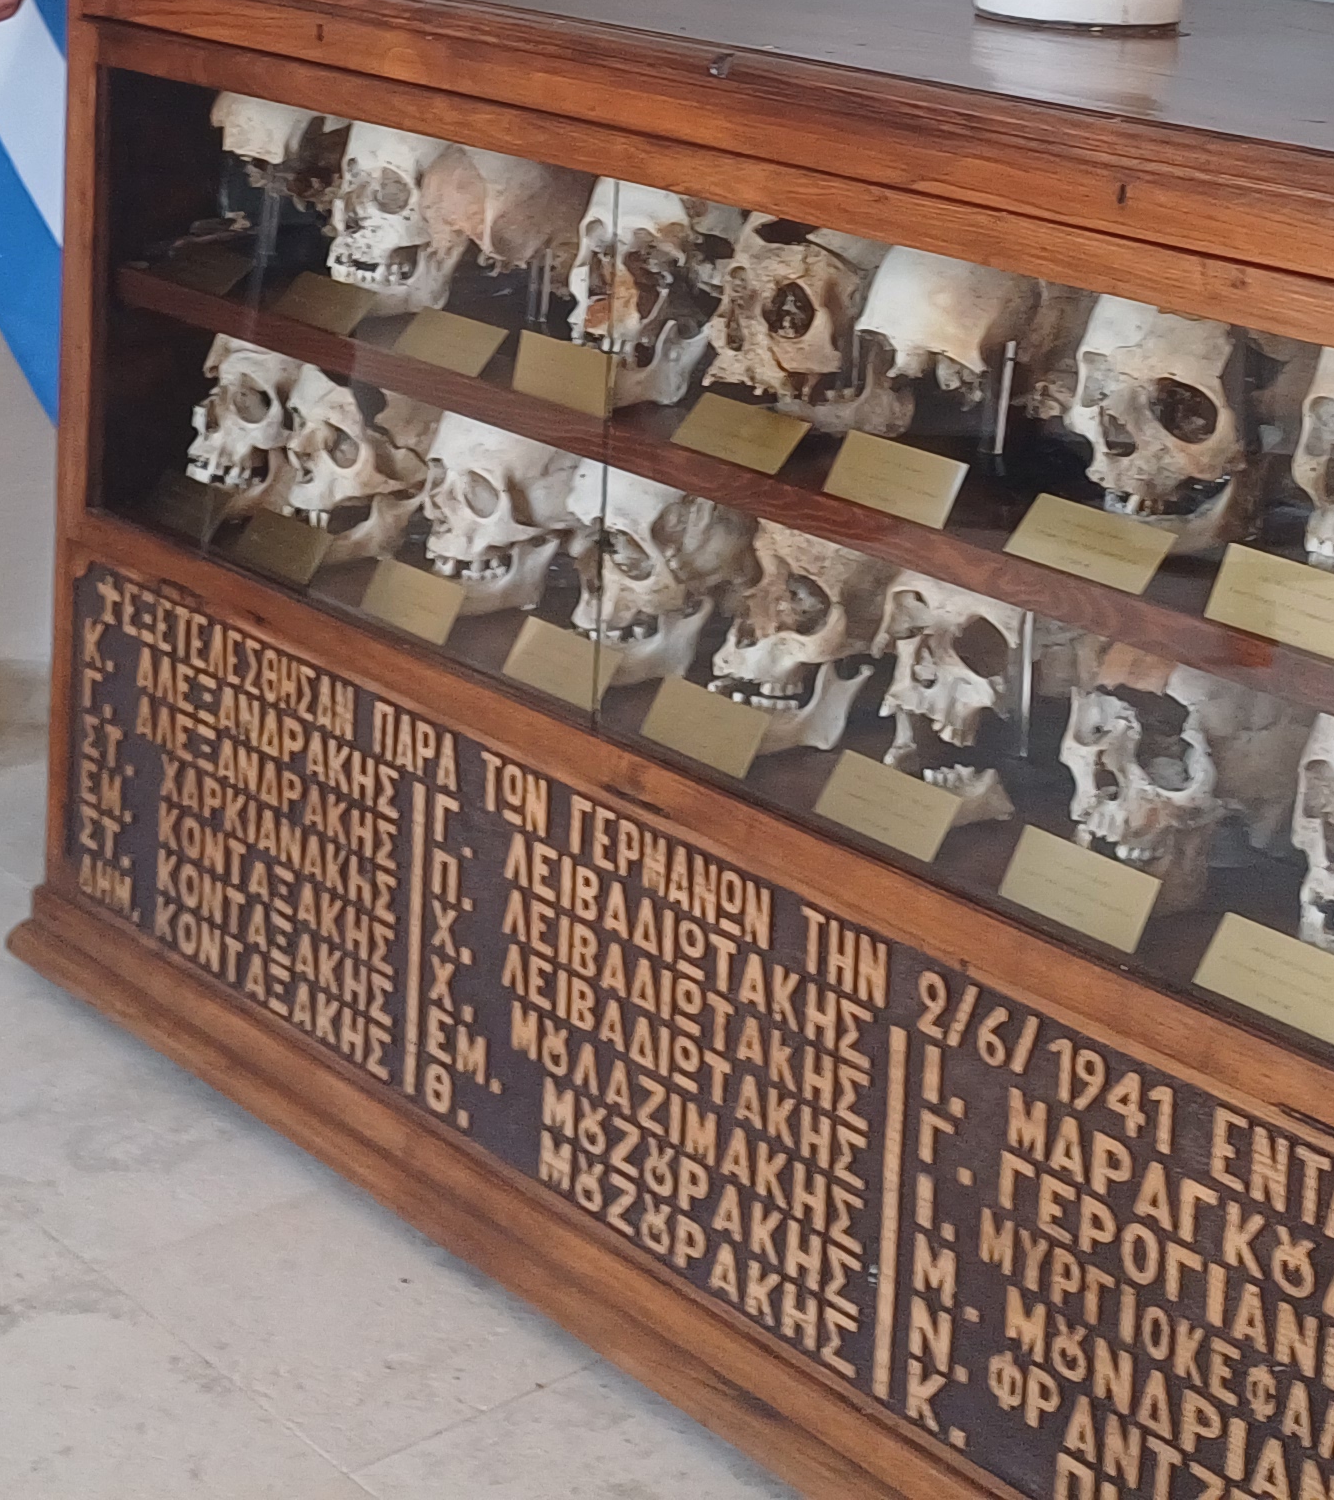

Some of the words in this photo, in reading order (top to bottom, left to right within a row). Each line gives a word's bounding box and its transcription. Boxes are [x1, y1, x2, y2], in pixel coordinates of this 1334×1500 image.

[135, 695, 398, 870] ΑΛΕΞΑΝΔΡΑΚΗΣ
[136, 646, 399, 820] ΑΛΕΞΑΝΔΡΑΚΗΣ
[157, 799, 394, 976] ΚΟΝΤΑΞΑΚΗΣ
[160, 753, 397, 925] ΧΑΡΚΙΑΝΑΚΗΣ
[372, 699, 458, 792] ΠΑΡΑ
[479, 750, 548, 839] ΤΩΝ
[800, 904, 889, 1009] ΤΗΝ
[916, 970, 1175, 1155] 2/6/1941
[154, 896, 392, 1081] ΚΟΝΤΑΞΑΚΗΣ
[156, 848, 393, 1029] ΚΟΝΤΑΞΑΚΗΣ
